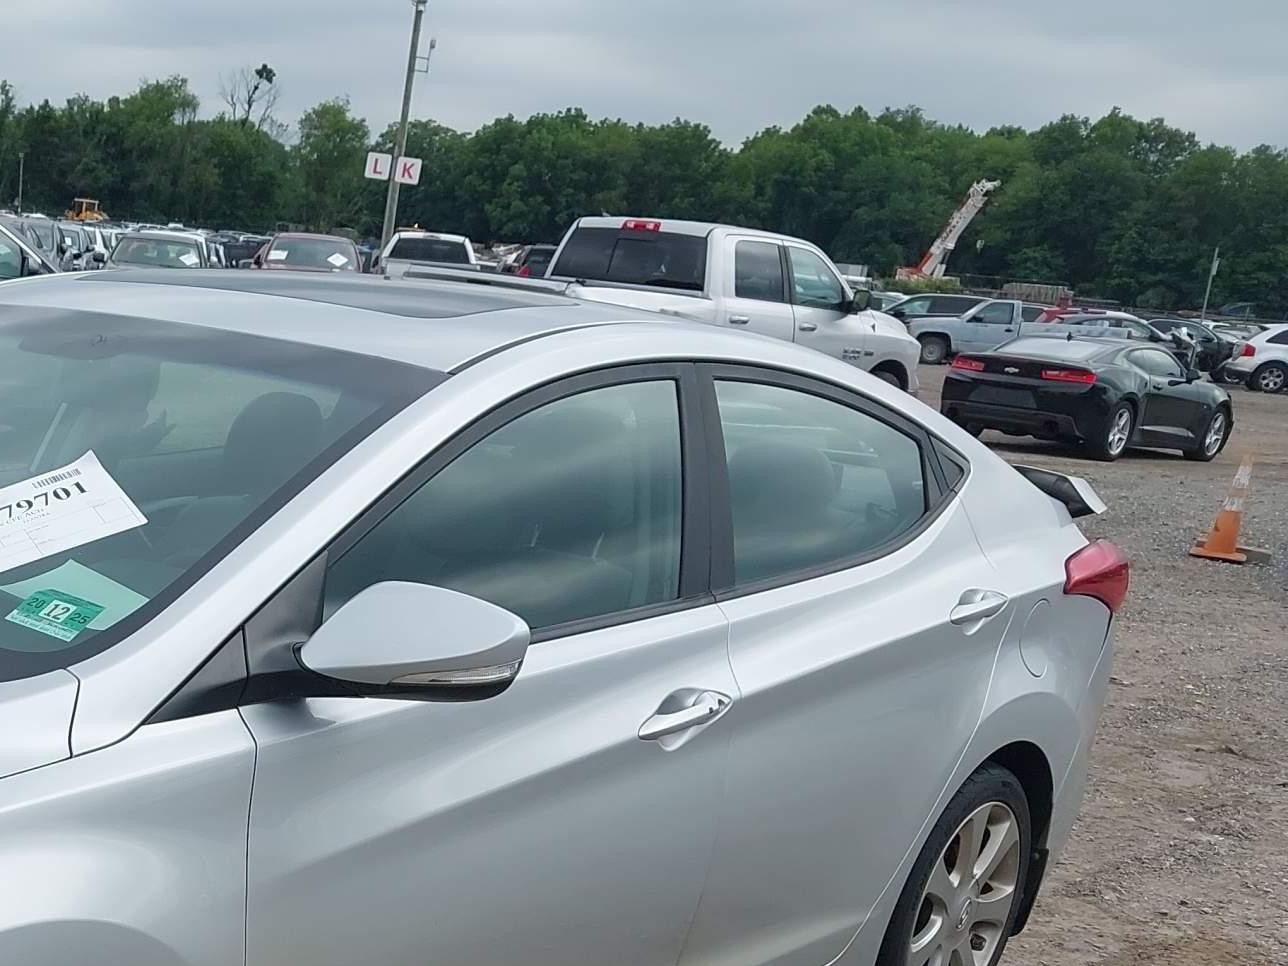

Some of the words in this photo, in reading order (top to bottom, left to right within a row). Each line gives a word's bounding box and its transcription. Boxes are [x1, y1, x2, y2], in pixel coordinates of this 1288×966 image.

[372, 158, 382, 175] L
[401, 162, 415, 179] K
[26, 597, 46, 609] 20
[43, 603, 71, 621] 12
[69, 612, 90, 624] 25
